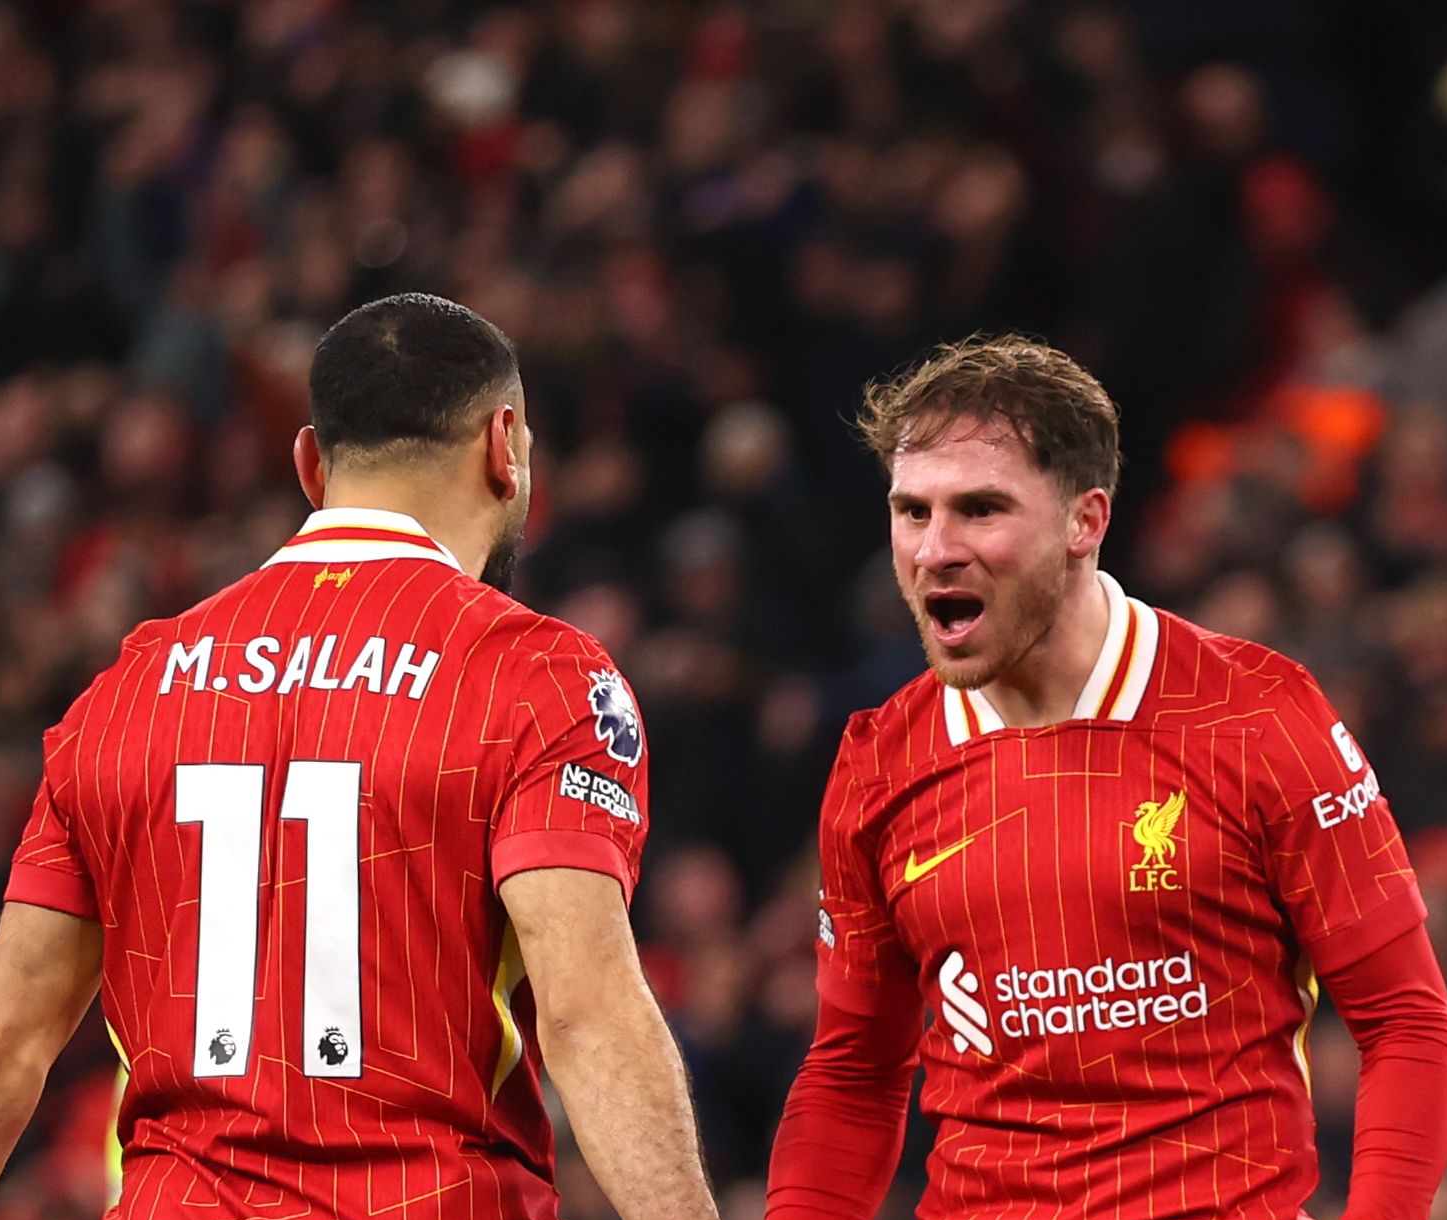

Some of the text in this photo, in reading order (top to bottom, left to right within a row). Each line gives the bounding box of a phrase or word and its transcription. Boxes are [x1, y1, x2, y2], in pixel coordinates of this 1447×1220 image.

[159, 634, 440, 700] M.SALAH
[560, 778, 641, 826] for racism
[562, 762, 631, 810] No room
[1129, 869, 1183, 892] L.F.C.
[174, 760, 363, 1079] 11
[995, 950, 1193, 1002] standard
[1000, 982, 1209, 1038] chartered
